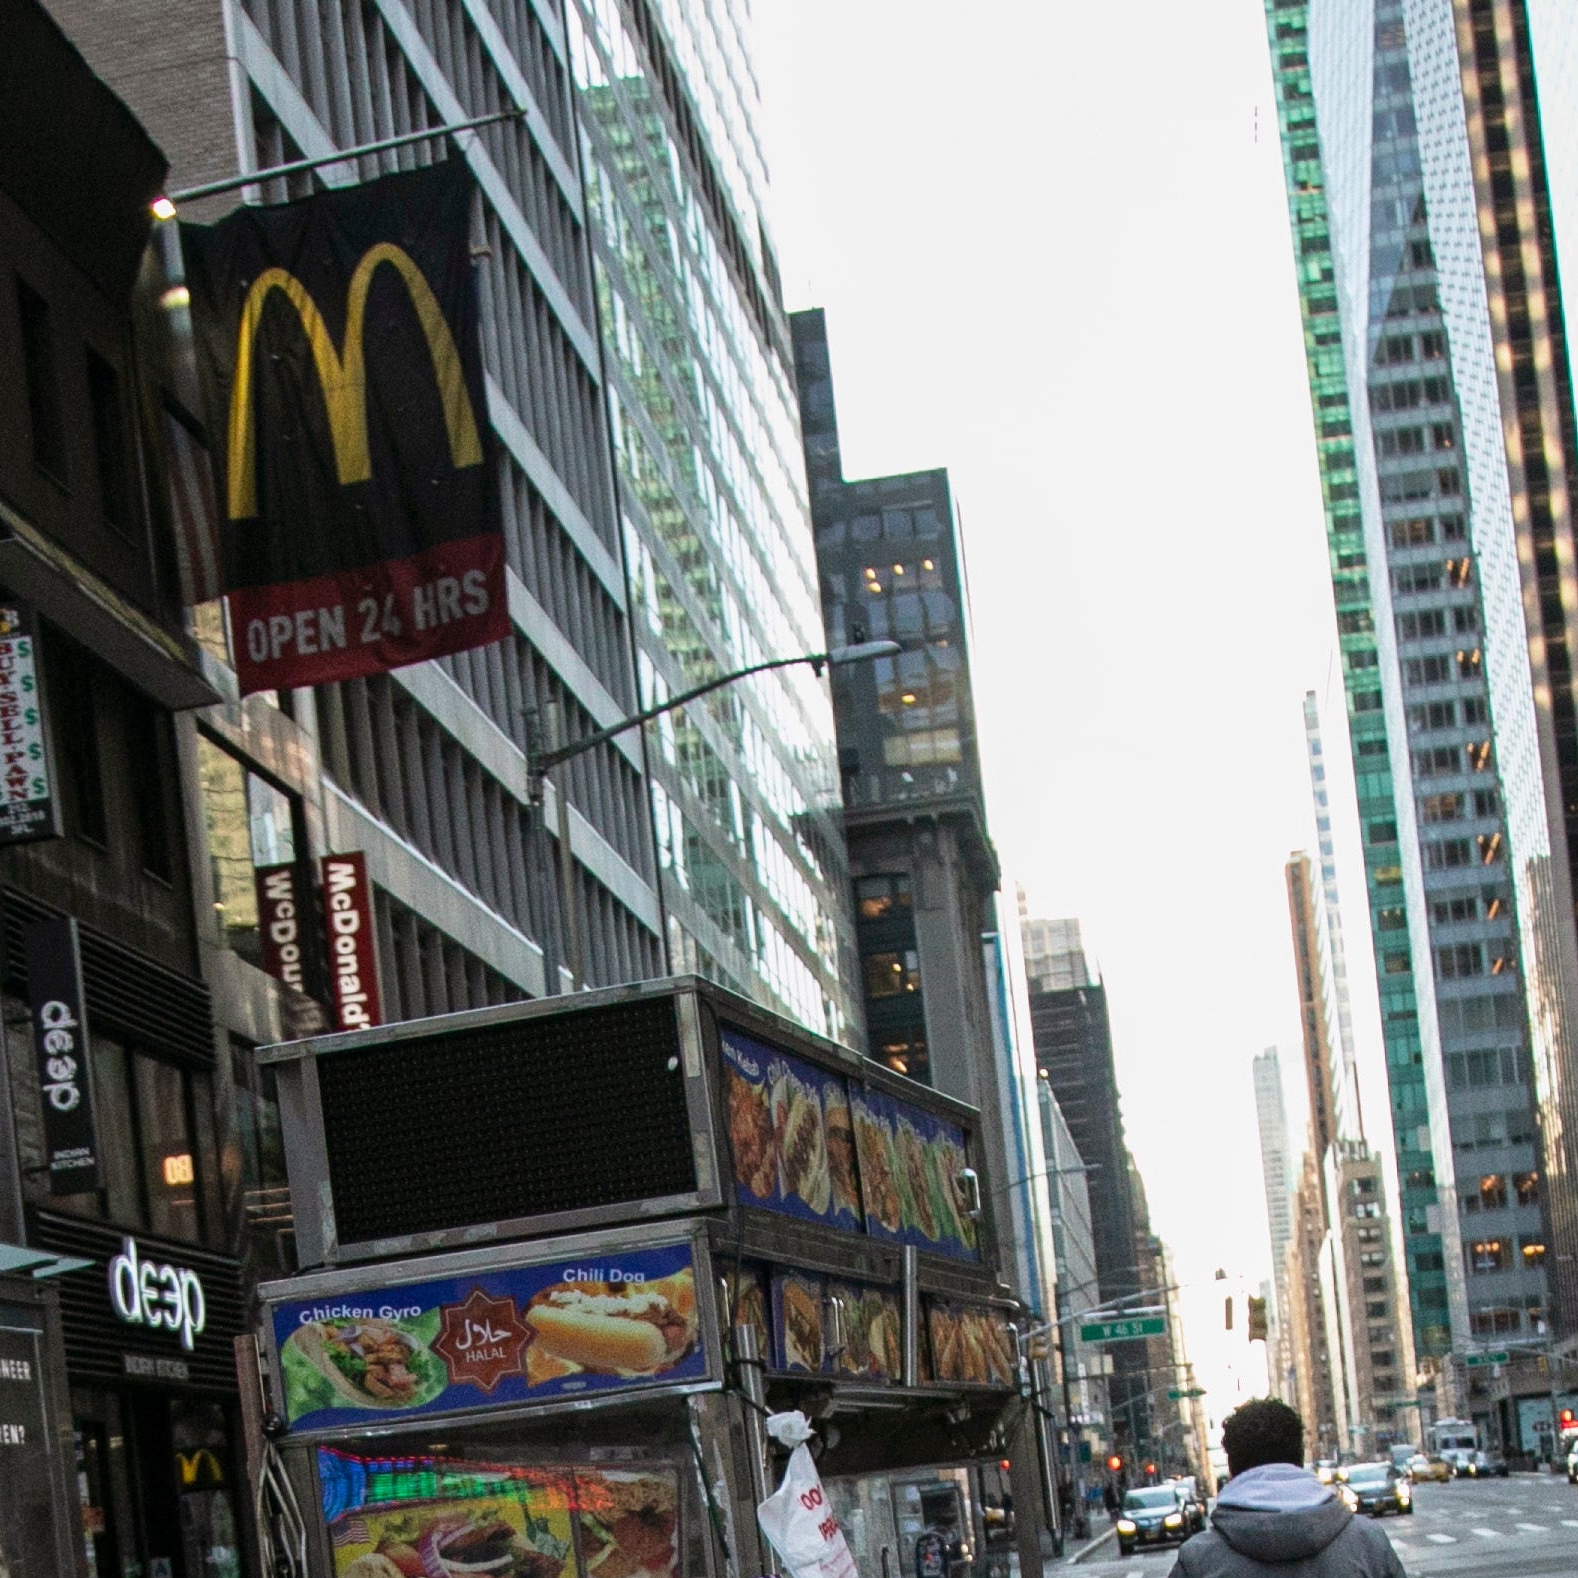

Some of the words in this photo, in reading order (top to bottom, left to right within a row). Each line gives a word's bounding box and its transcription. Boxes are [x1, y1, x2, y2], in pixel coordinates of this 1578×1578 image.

[246, 605, 347, 664] OPEN
[357, 593, 402, 643] 24
[412, 568, 490, 631] HRS
[326, 862, 371, 1030] McDonald'
[40, 1000, 81, 1111] deep
[108, 1235, 206, 1350] deep
[563, 1268, 604, 1283] Chili
[608, 1268, 645, 1285] Dog
[299, 1305, 376, 1324] Chicken
[378, 1303, 421, 1322] Gyro
[456, 1318, 512, 1350] حلال
[465, 1348, 507, 1362] HALAL
